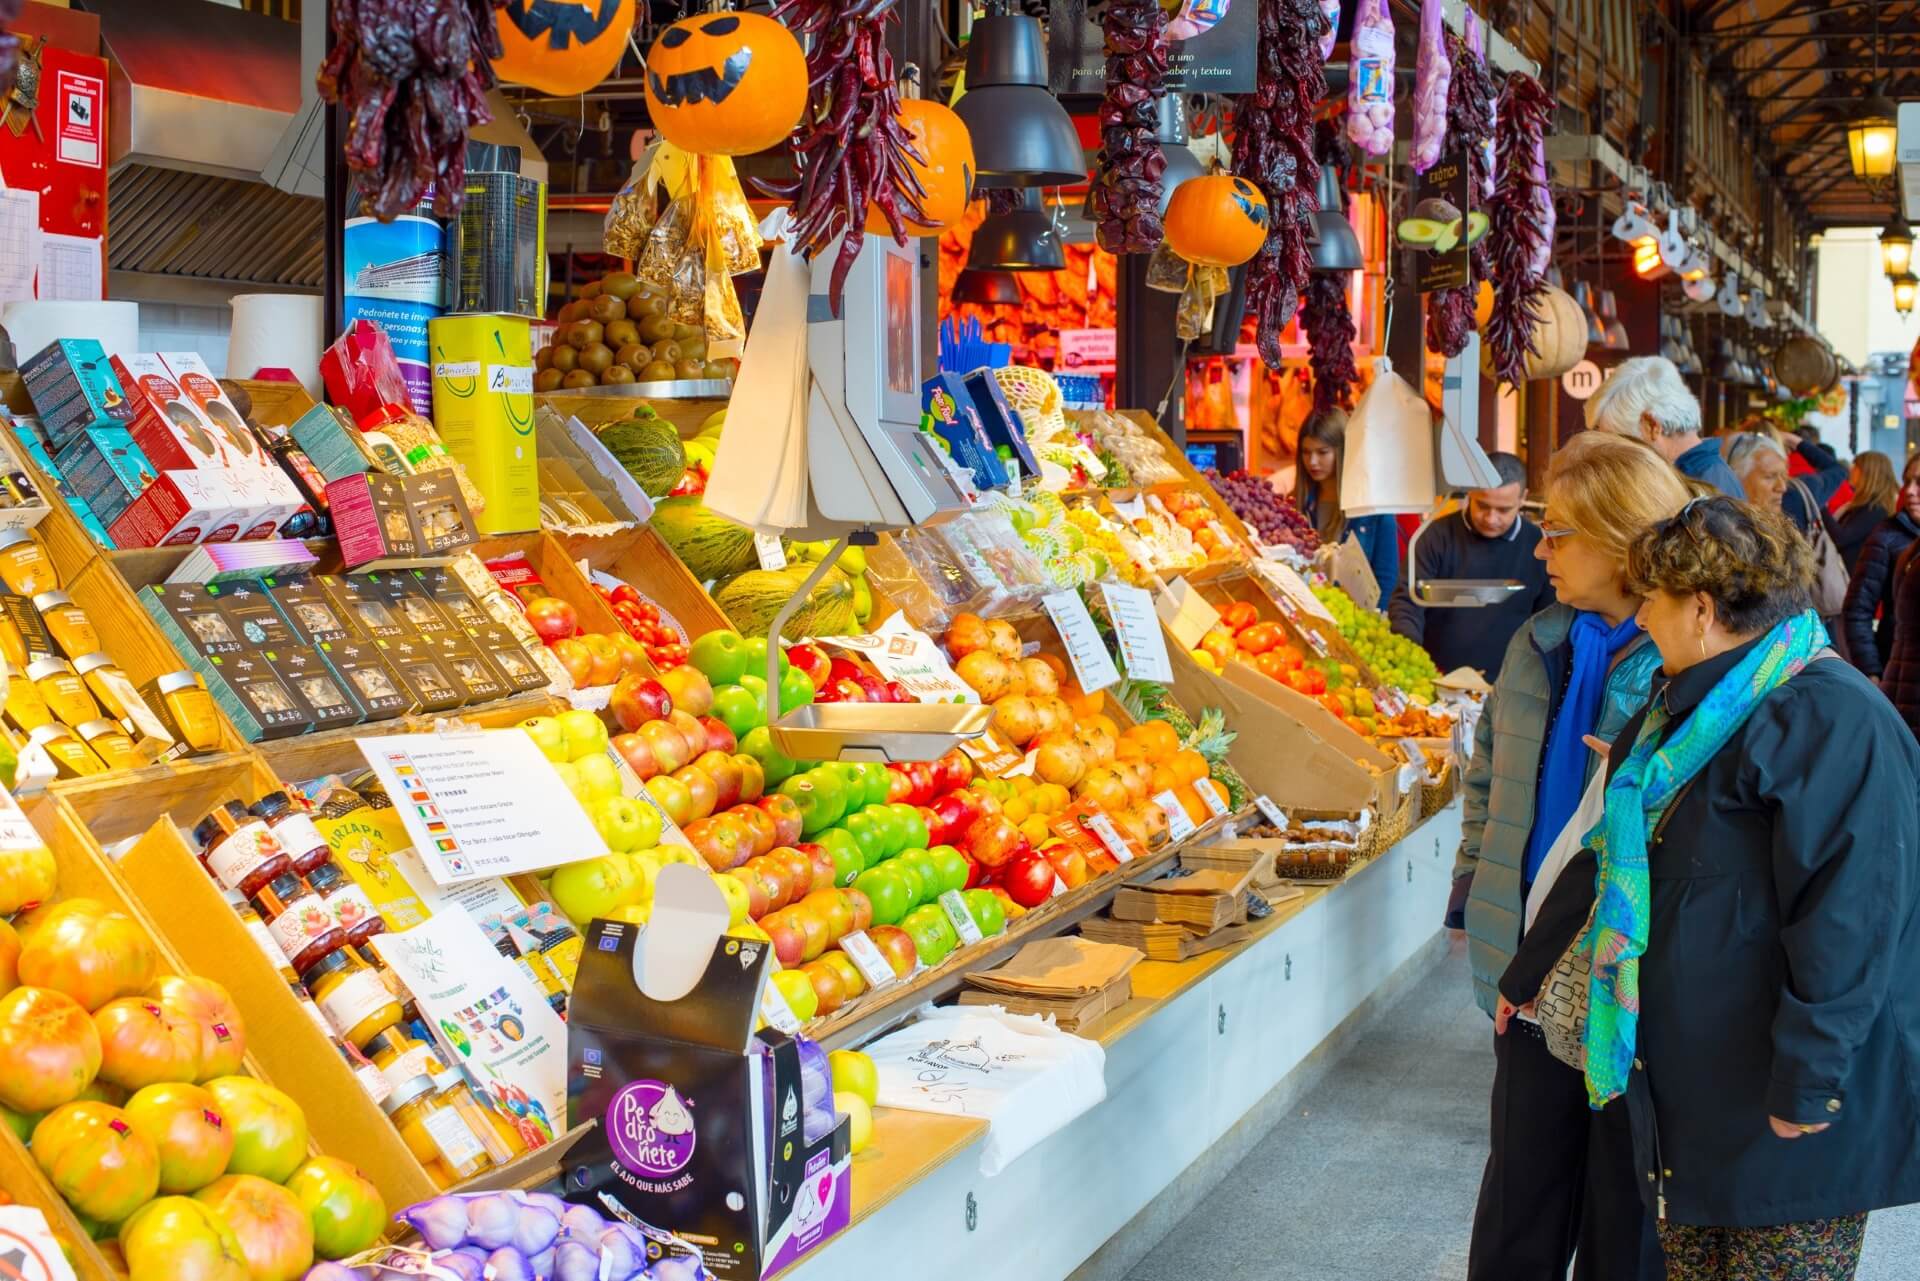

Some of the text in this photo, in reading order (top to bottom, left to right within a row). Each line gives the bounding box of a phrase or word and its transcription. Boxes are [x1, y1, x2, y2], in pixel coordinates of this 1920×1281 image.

[1177, 54, 1195, 62] uno
[1072, 67, 1092, 79] para
[1200, 66, 1232, 76] textura
[401, 312, 410, 321] te
[384, 324, 420, 334] personas
[330, 823, 384, 849] URZAPA
[610, 1160, 695, 1194] EL AJO QUE MÁS SABE
